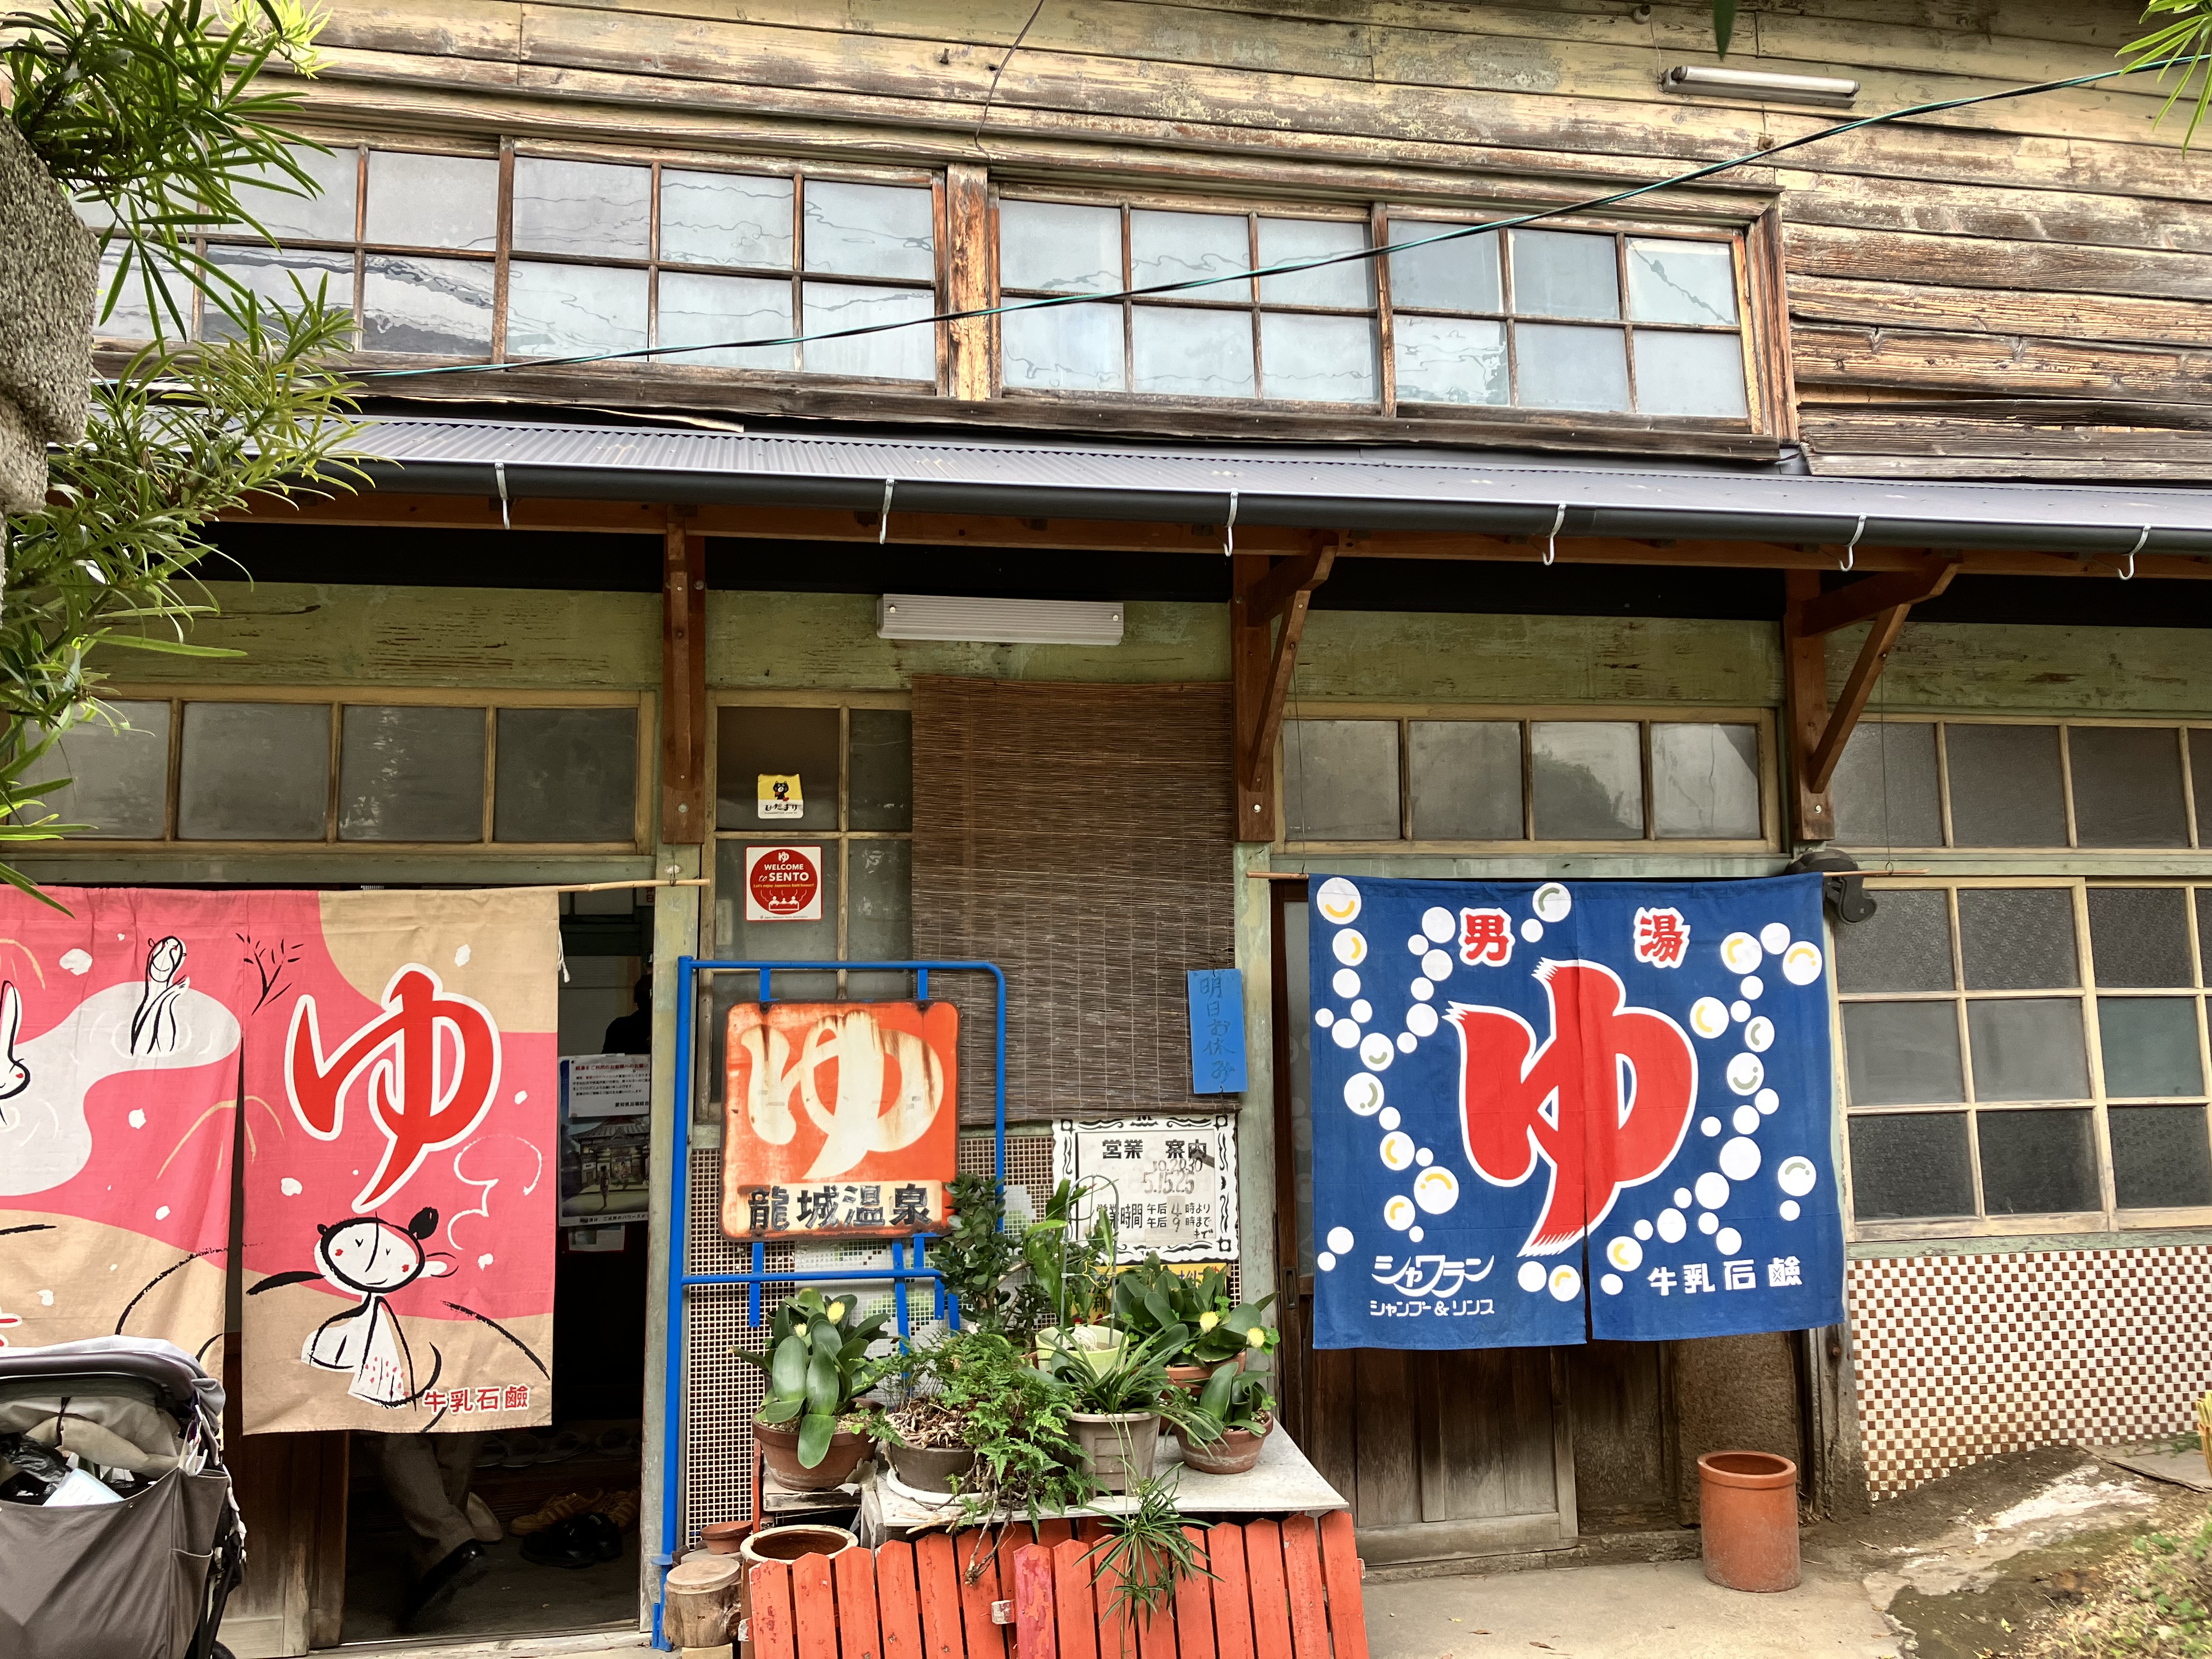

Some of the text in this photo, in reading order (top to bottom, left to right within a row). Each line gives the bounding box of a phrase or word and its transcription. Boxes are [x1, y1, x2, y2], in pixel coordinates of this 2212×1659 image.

[765, 803, 798, 811] ひだまり
[769, 872, 809, 882] SENTO
[778, 851, 790, 863] ゆ
[1464, 912, 1686, 964] 男 湯
[1200, 976, 1238, 1084] 明日お休み
[286, 964, 500, 1210] ゆ
[741, 1009, 944, 1180] ゆ
[1443, 958, 1697, 1256] ゆ
[1102, 1138, 1207, 1159] 営業 案内
[748, 1183, 932, 1231] 龍城温泉
[1371, 1255, 1495, 1299] シャワラン
